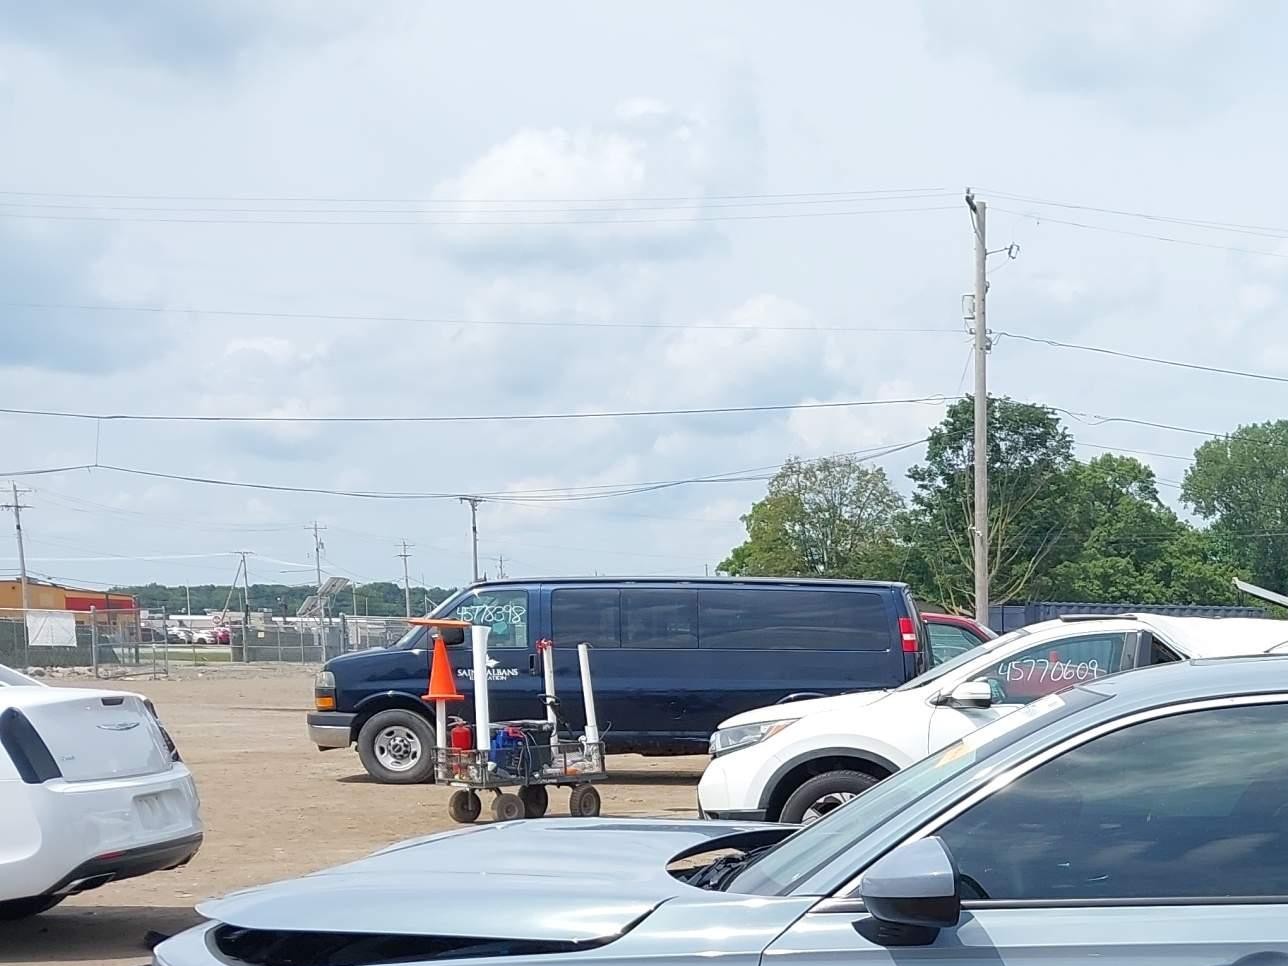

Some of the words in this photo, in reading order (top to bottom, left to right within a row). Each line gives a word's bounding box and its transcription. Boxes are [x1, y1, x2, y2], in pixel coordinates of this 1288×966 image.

[457, 668, 475, 677] SAIN
[486, 668, 519, 676] ALBANS
[998, 659, 1099, 682] 45770609
